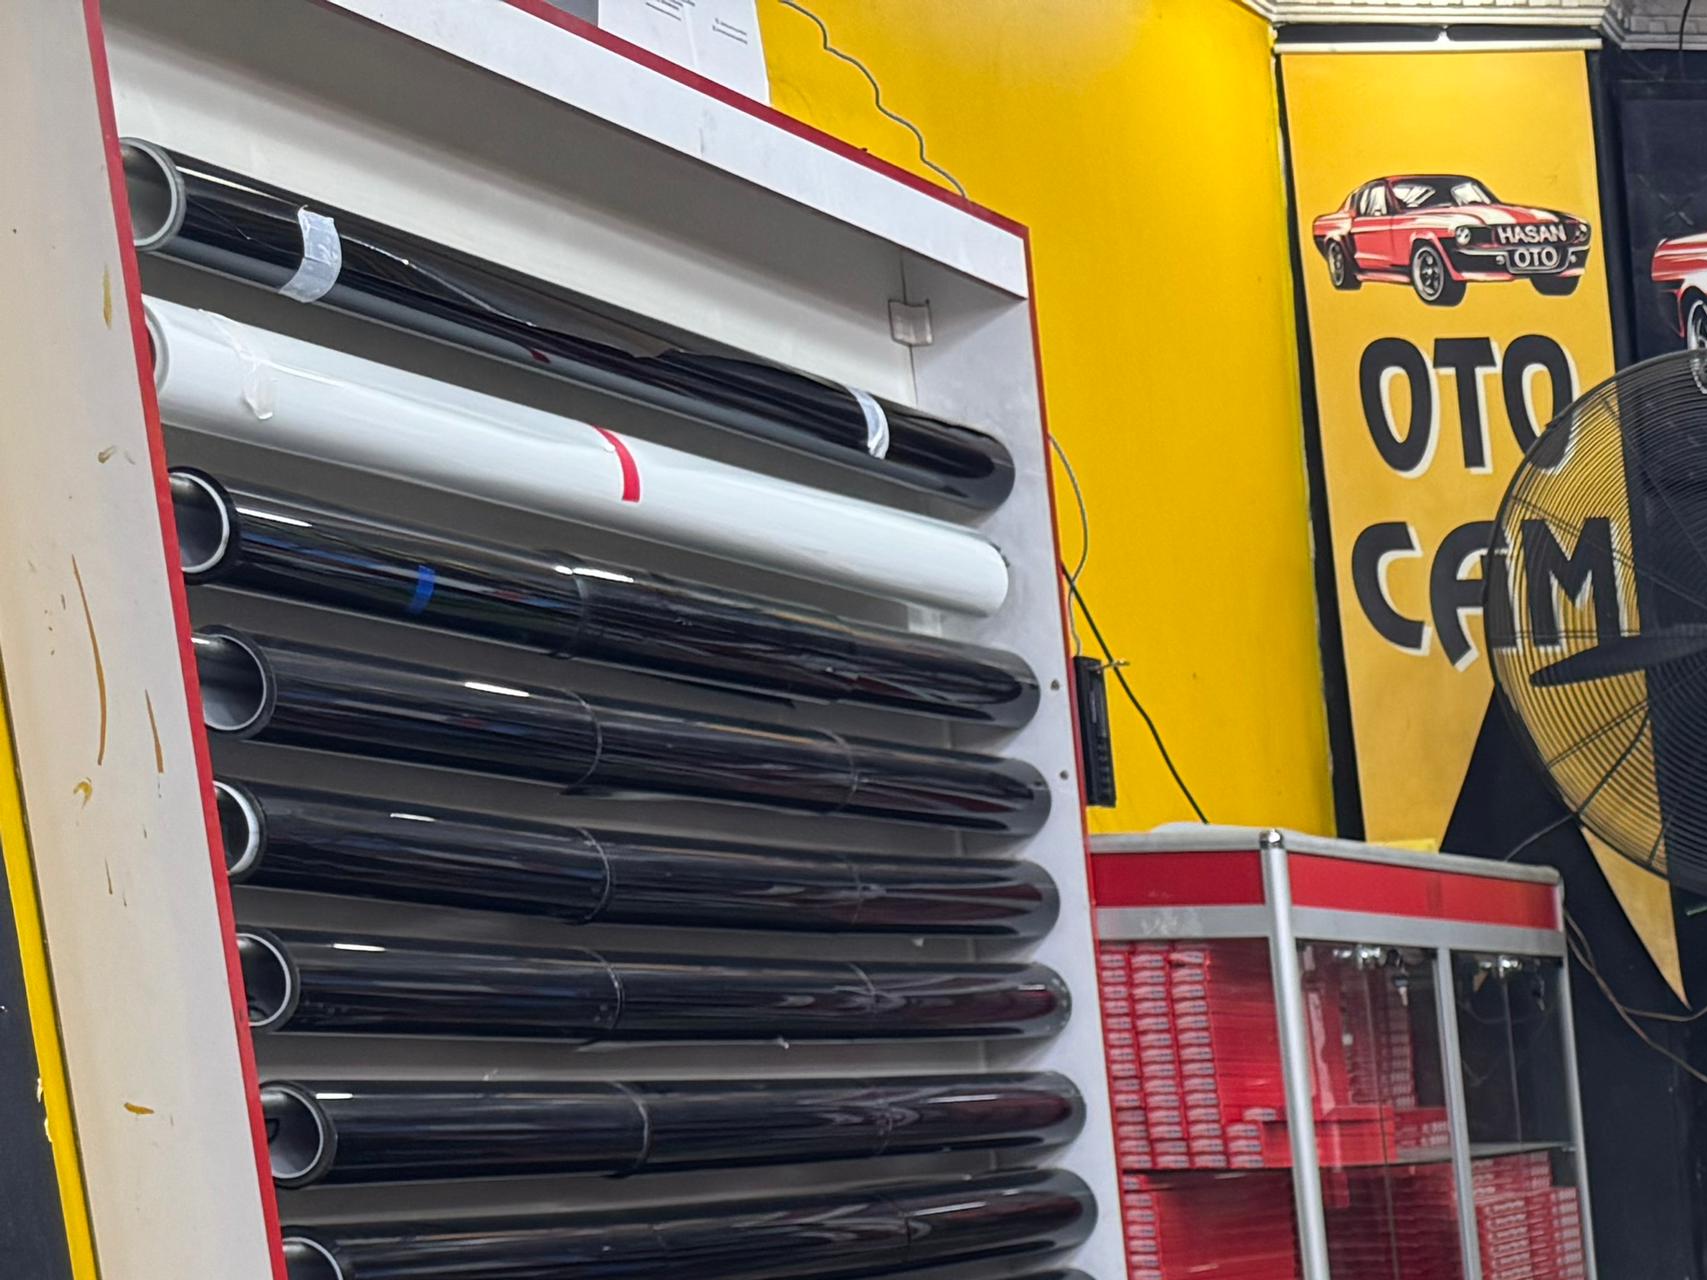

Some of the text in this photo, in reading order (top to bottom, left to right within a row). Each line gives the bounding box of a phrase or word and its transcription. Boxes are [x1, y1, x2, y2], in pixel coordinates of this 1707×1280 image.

[1499, 223, 1566, 244] HASAN
[1514, 246, 1558, 269] OTO
[1360, 334, 1578, 478] OTO
